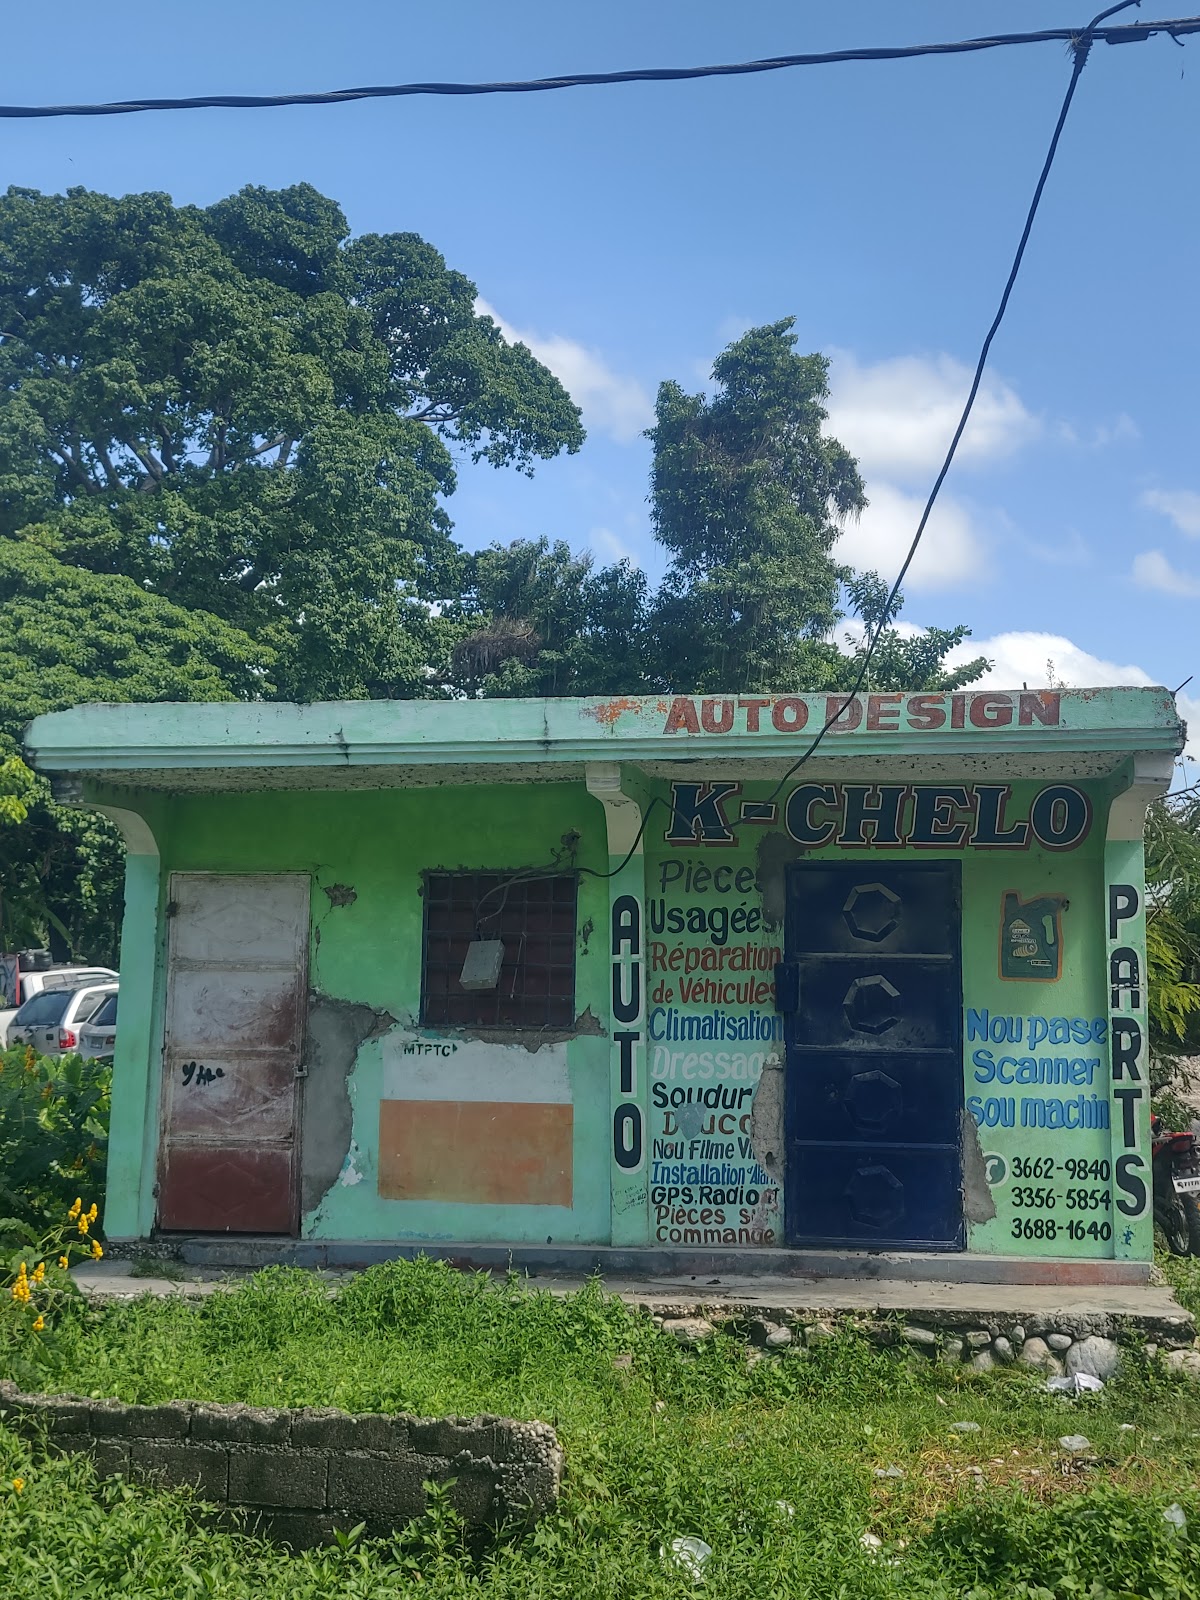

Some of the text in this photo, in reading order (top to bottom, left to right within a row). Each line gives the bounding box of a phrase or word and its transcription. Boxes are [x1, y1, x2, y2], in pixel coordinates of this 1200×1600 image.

[663, 692, 1061, 734] AUTO DESIGN
[651, 942, 781, 974] Réparation
[652, 979, 674, 1003] de
[612, 894, 645, 1174] AUTO
[650, 1007, 783, 1041] Climatisation
[966, 1008, 1108, 1050] Nou pase
[972, 1049, 1101, 1085] Scanner
[1108, 884, 1151, 1221] PARTS
[966, 1093, 1109, 1130] sou machin
[653, 1138, 685, 1160] Nou
[689, 1139, 735, 1160] Filme
[651, 1161, 746, 1185] Installation
[1012, 1157, 1111, 1182] 3662-9840
[654, 1204, 727, 1226] Pièces
[1011, 1187, 1112, 1211] 3356-5854
[1011, 1217, 1112, 1241] 3688-1640
